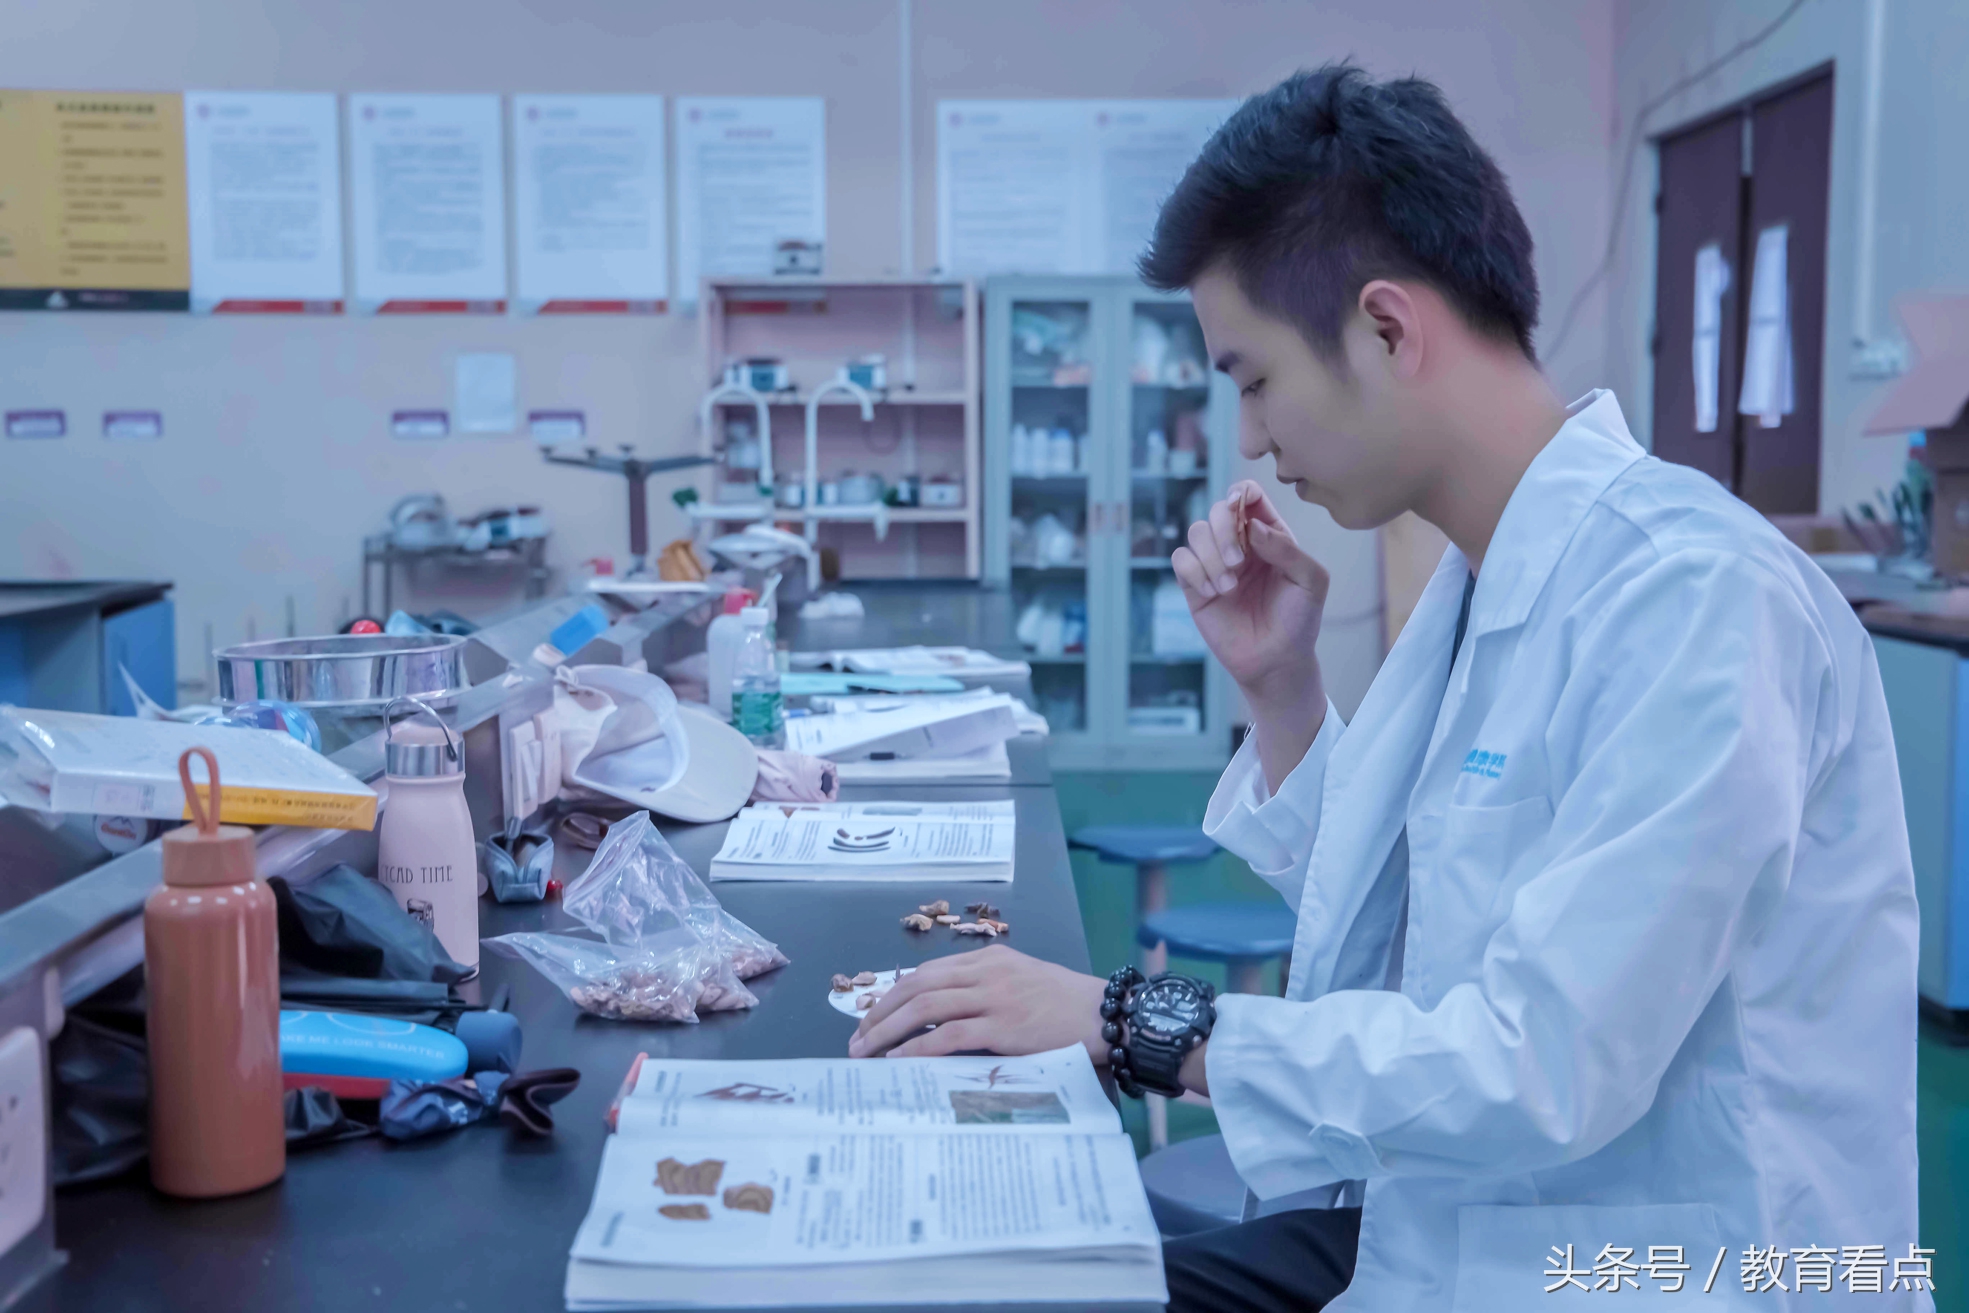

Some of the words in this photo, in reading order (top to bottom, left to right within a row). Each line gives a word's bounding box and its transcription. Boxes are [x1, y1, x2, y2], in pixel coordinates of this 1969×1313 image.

[420, 864, 454, 884] TIME
[308, 1034, 331, 1046] ME
[377, 1040, 445, 1059] SMARTER
